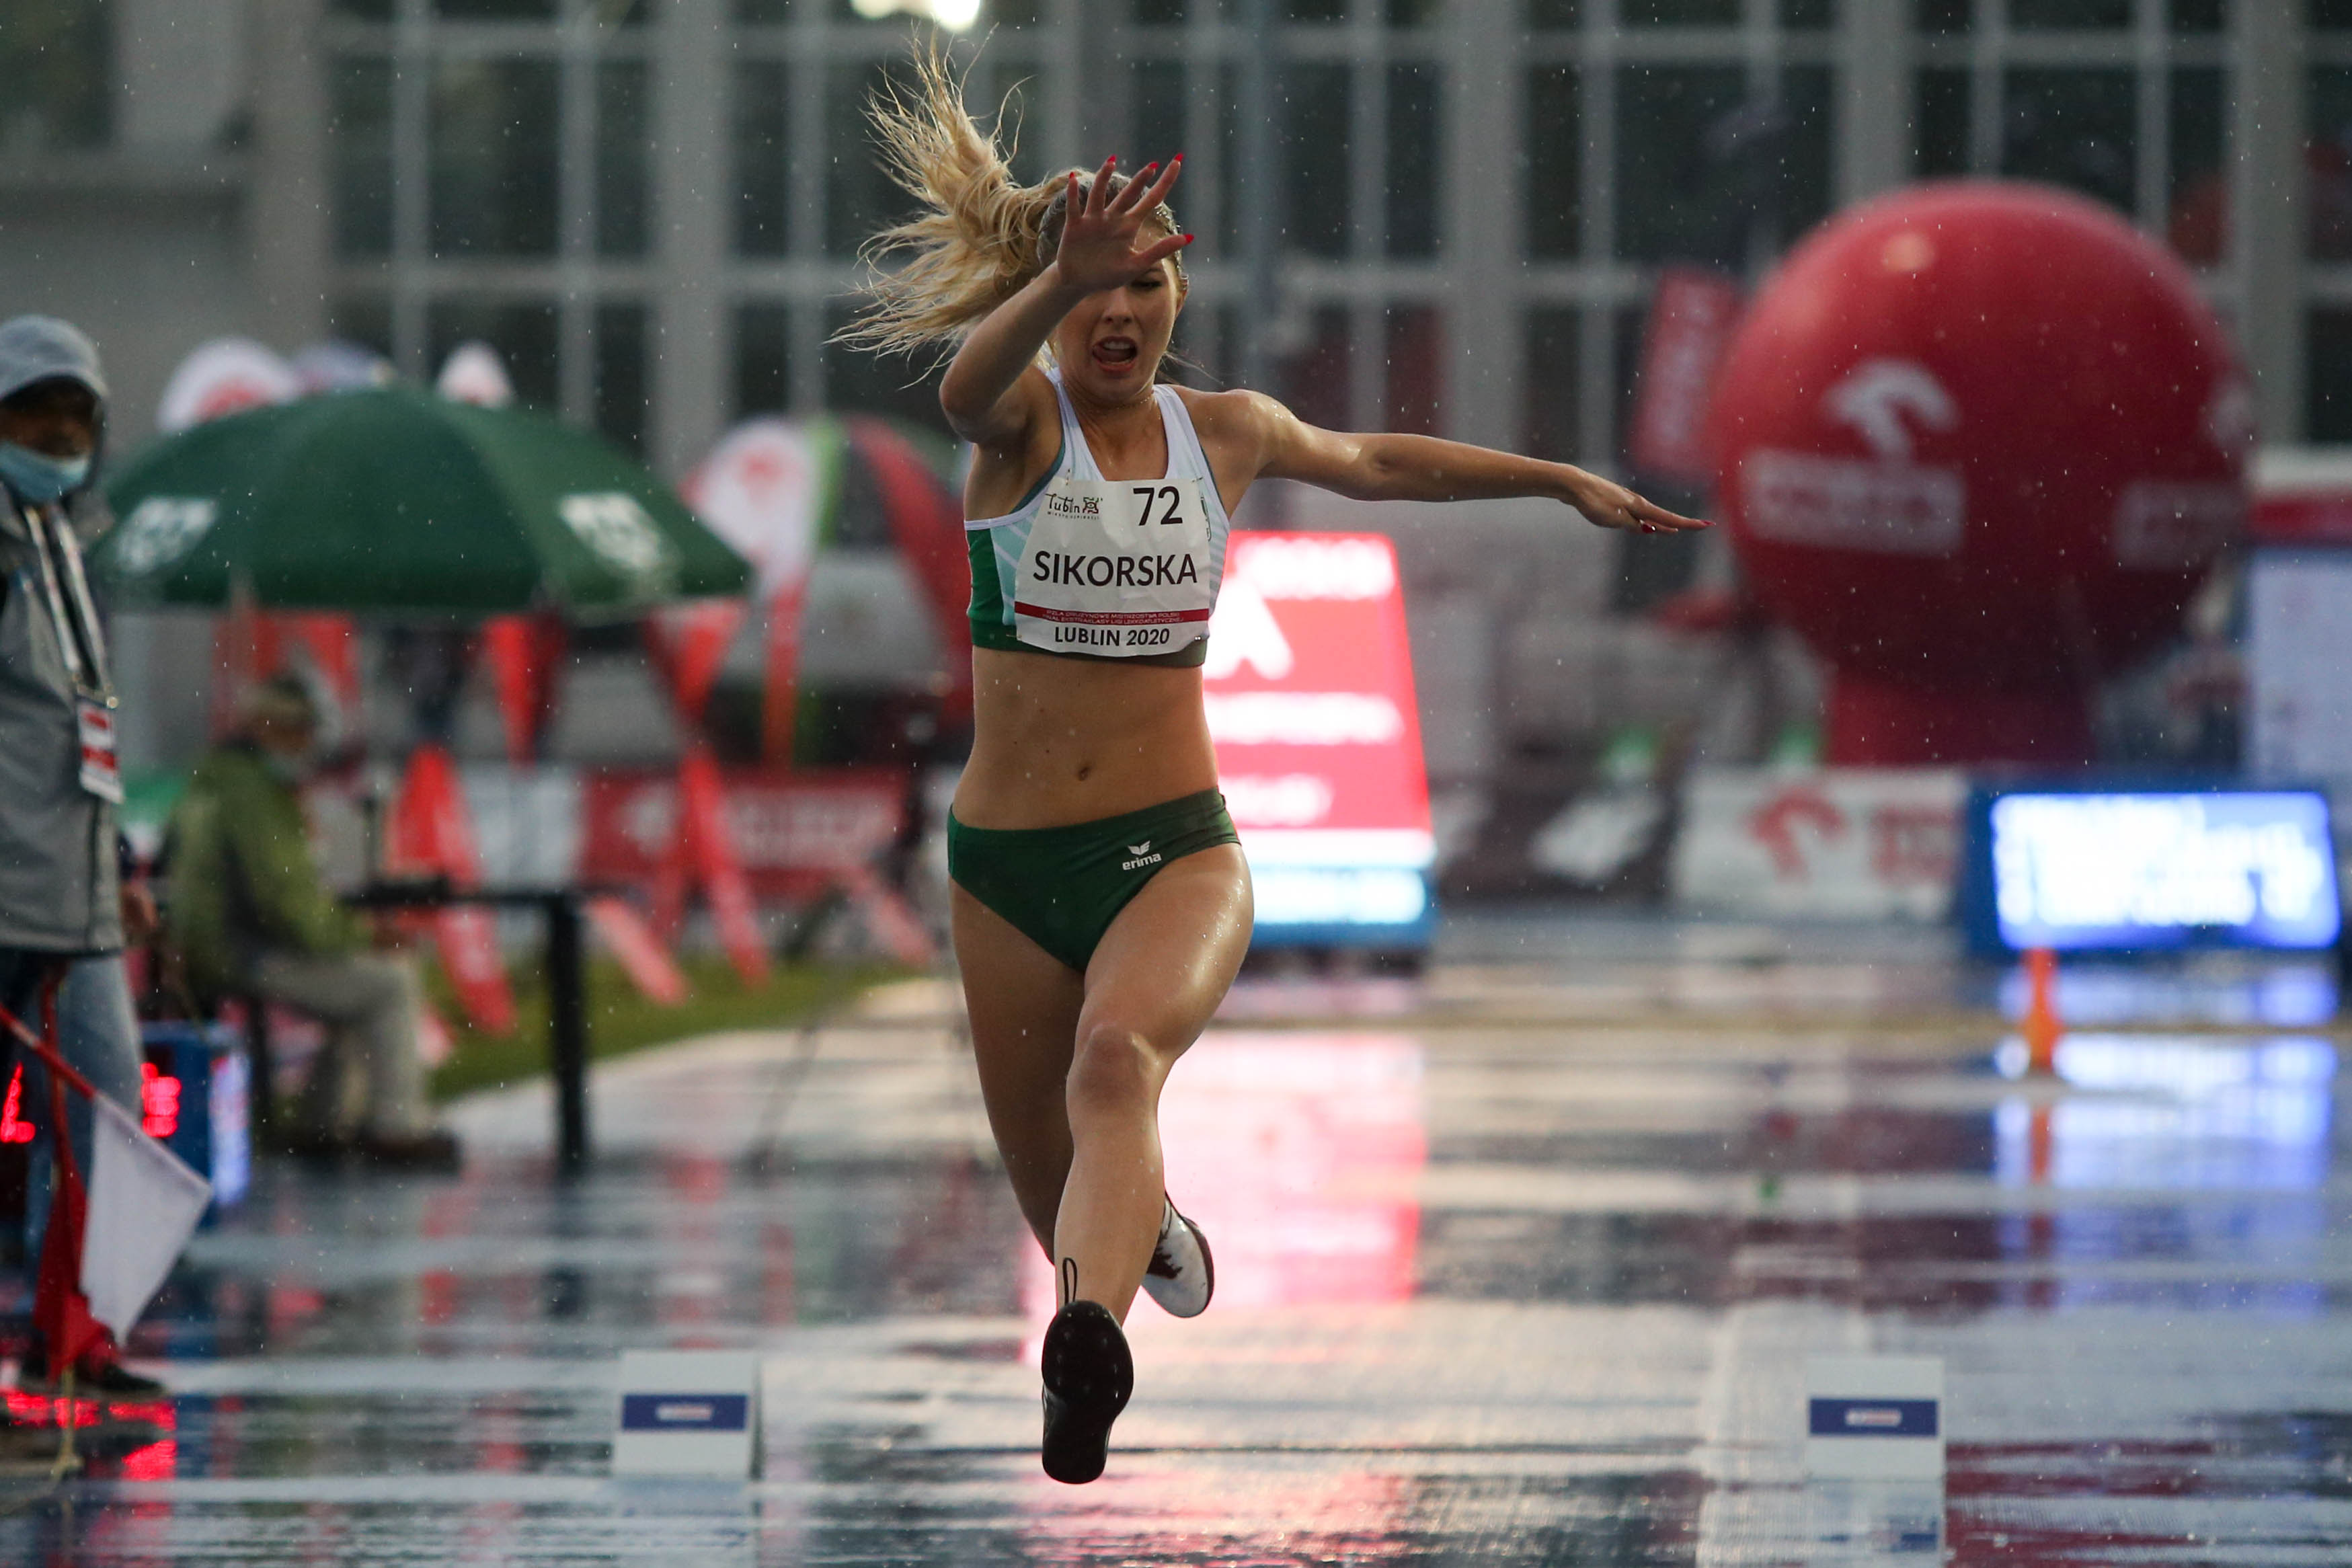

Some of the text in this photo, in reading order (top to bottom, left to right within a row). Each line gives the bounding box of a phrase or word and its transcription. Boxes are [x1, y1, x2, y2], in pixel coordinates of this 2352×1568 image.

[1133, 486, 1183, 526] 72
[1033, 550, 1198, 587] SIKORSKA
[1055, 627, 1170, 646] LUBLIN 2020
[1122, 853, 1162, 871] erima
